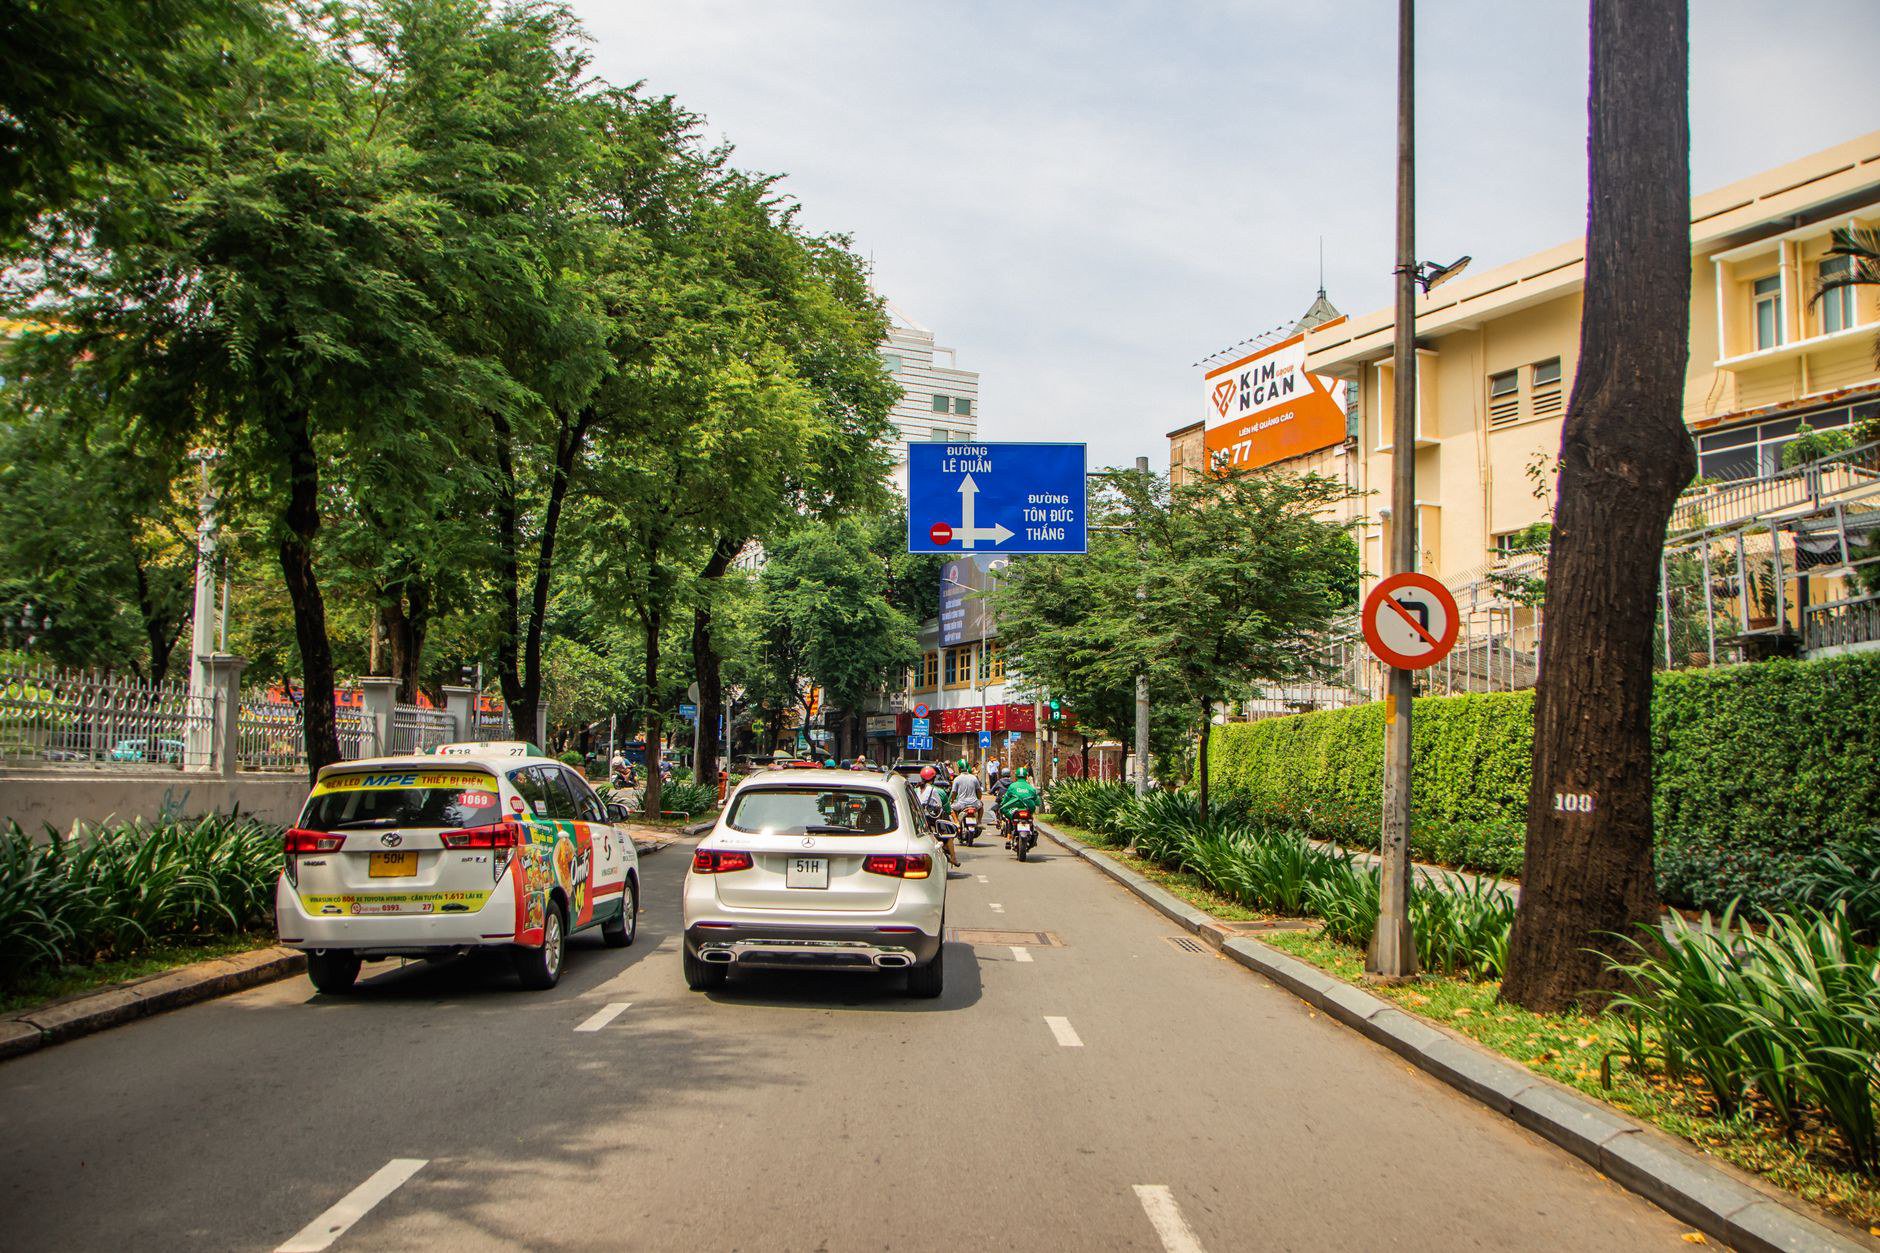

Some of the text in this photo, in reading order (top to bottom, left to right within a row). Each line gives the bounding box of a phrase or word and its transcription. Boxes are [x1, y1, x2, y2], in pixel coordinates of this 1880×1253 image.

[1240, 361, 1275, 391] KIM
[1239, 374, 1294, 411] NGAN
[946, 445, 988, 456] ĐƯỜNG
[1231, 439, 1253, 465] 77
[942, 455, 992, 473] LÊ DUẨN
[1027, 492, 1069, 504] ĐƯỜNG
[1023, 506, 1074, 522] TÔN ĐỨC
[1026, 523, 1065, 541] THẮNG
[510, 748, 524, 756] 27
[343, 777, 361, 788] LED
[362, 774, 418, 787] MPE
[421, 773, 447, 785] THIẾT
[449, 776, 460, 787] BỊ
[461, 776, 484, 788] ĐIỆN
[384, 853, 405, 864] 50H
[796, 859, 819, 873] 51H
